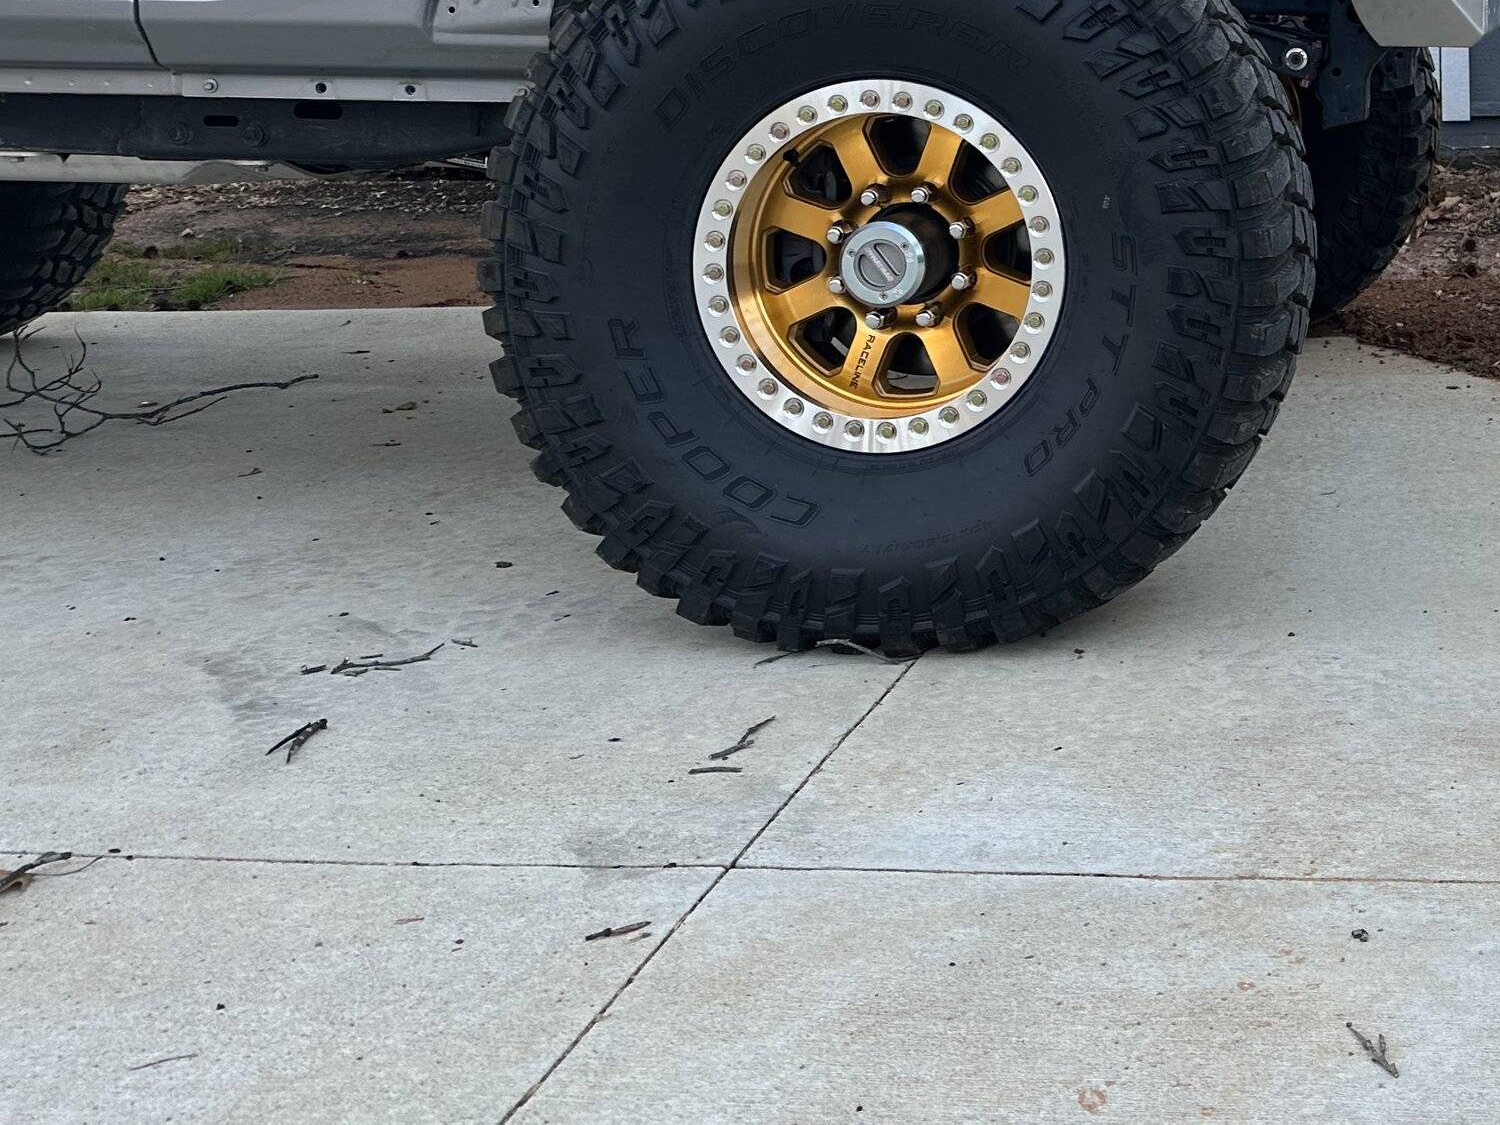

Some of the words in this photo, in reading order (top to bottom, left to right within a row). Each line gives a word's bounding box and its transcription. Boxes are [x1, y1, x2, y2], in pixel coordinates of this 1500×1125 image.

[654, 1, 1032, 133] DISCOVERER
[849, 334, 876, 389] RACELINE
[1102, 230, 1139, 377] STT
[607, 315, 823, 530] COOPER
[1023, 376, 1102, 478] PRO
